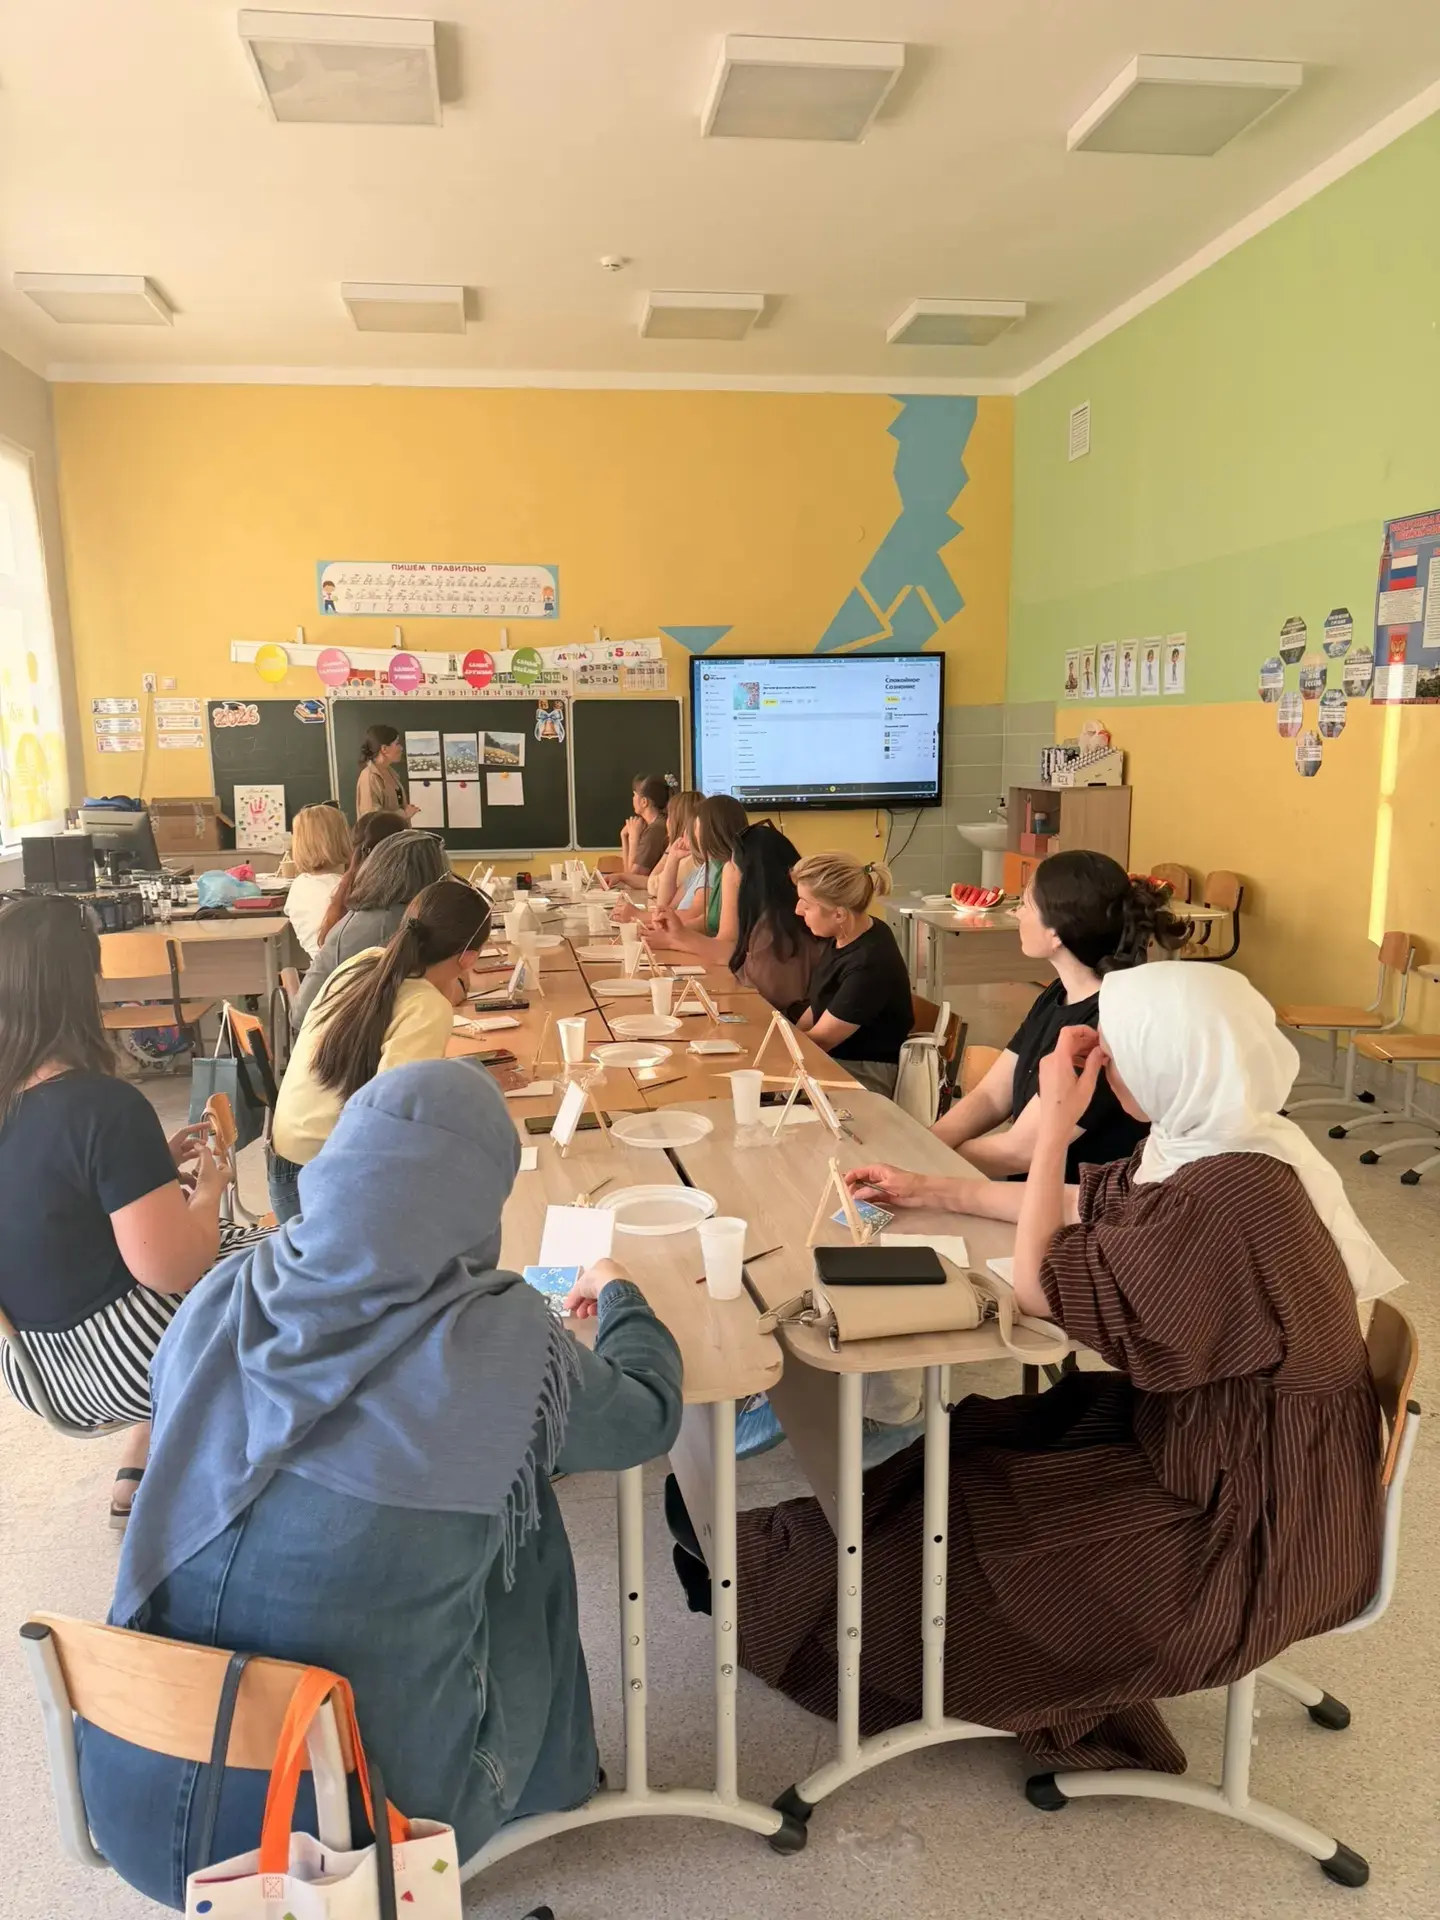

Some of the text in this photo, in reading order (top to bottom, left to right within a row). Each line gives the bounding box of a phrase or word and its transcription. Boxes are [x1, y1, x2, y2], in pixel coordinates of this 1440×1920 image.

[391, 563, 487, 572] ПИШЕМ ПРАВИЛЬНО
[355, 602, 360, 612] 0
[386, 603, 394, 612] 2
[403, 602, 409, 613] 3
[435, 603, 442, 613] 5
[451, 603, 457, 613] 6
[468, 604, 474, 613] 7
[483, 604, 489, 614] 8
[500, 604, 506, 614] 9
[517, 605, 530, 614] 10
[615, 647, 624, 657] 5
[214, 706, 258, 726] 2026
